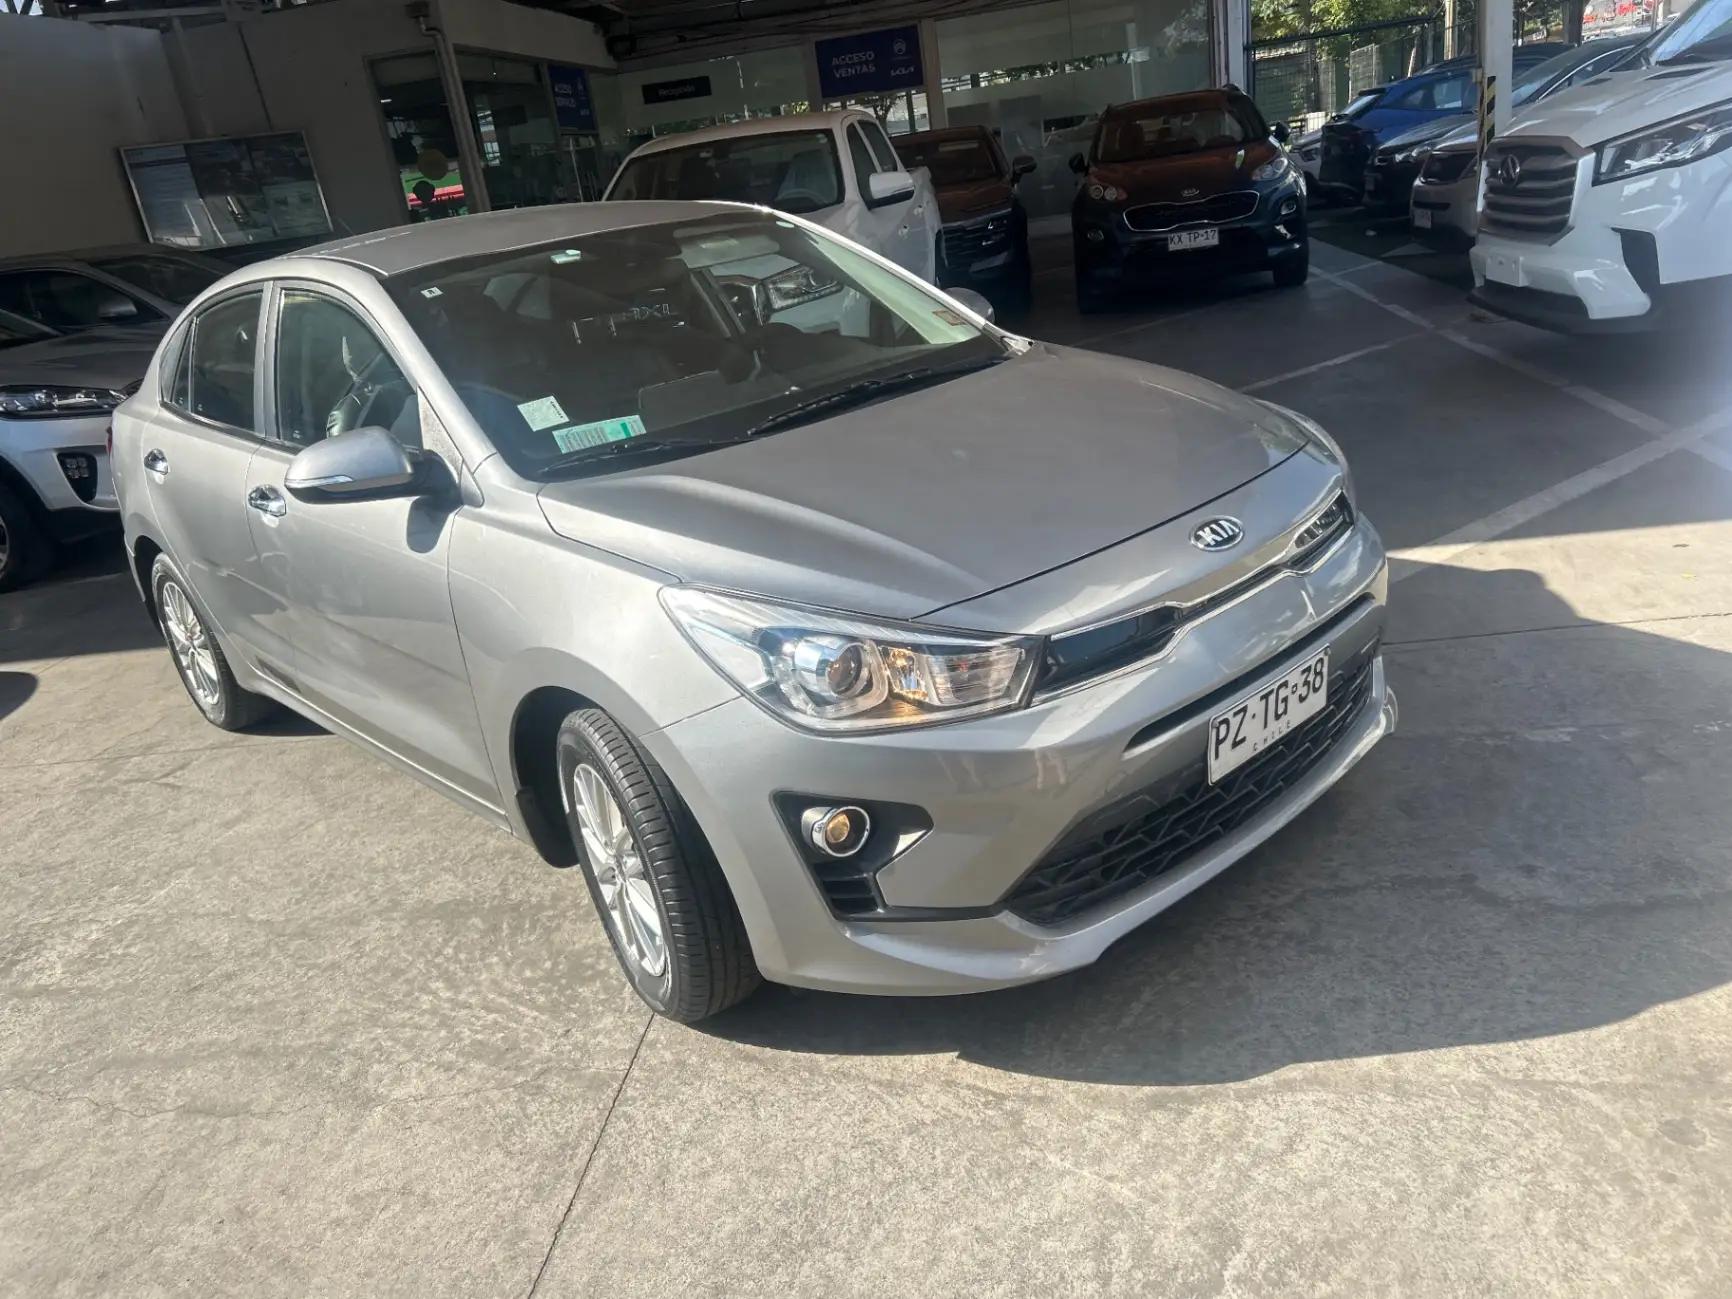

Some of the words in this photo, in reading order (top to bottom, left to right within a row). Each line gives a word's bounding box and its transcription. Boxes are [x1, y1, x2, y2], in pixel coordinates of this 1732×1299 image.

[831, 50, 875, 66] ACCESO
[833, 64, 876, 79] VENTAS
[1196, 519, 1240, 546] KIA
[1252, 719, 1291, 752] CHILE
